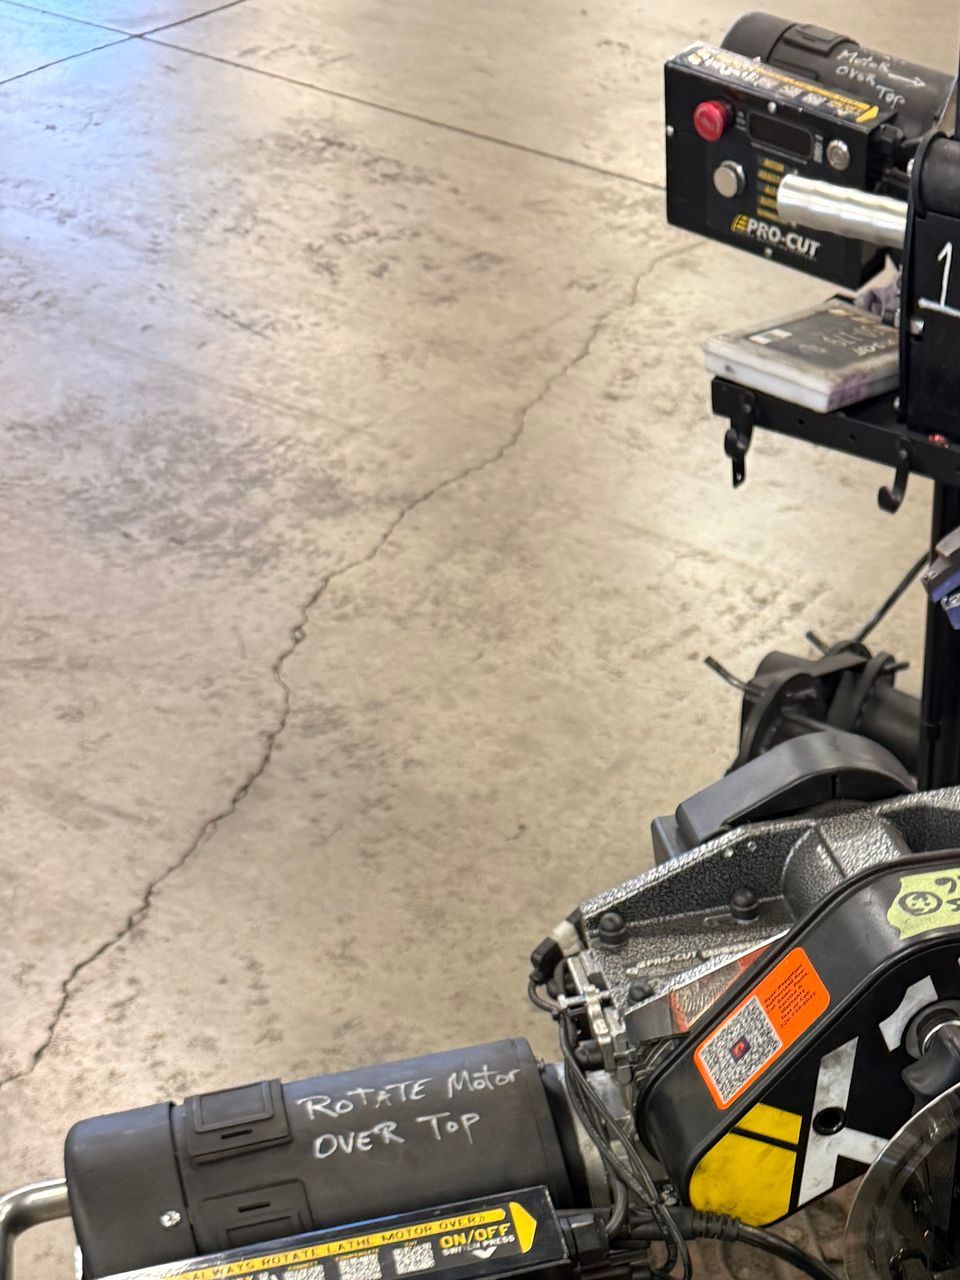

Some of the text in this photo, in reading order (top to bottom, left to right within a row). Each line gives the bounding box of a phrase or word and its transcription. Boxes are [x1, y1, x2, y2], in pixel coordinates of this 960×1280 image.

[747, 218, 821, 257] PRO-CUT
[314, 1121, 405, 1158] OVER
[262, 1246, 321, 1267] ROTATE
[326, 1239, 372, 1255] LATHE
[381, 1225, 433, 1242] MOTOR
[439, 1221, 511, 1249] ON/OFF
